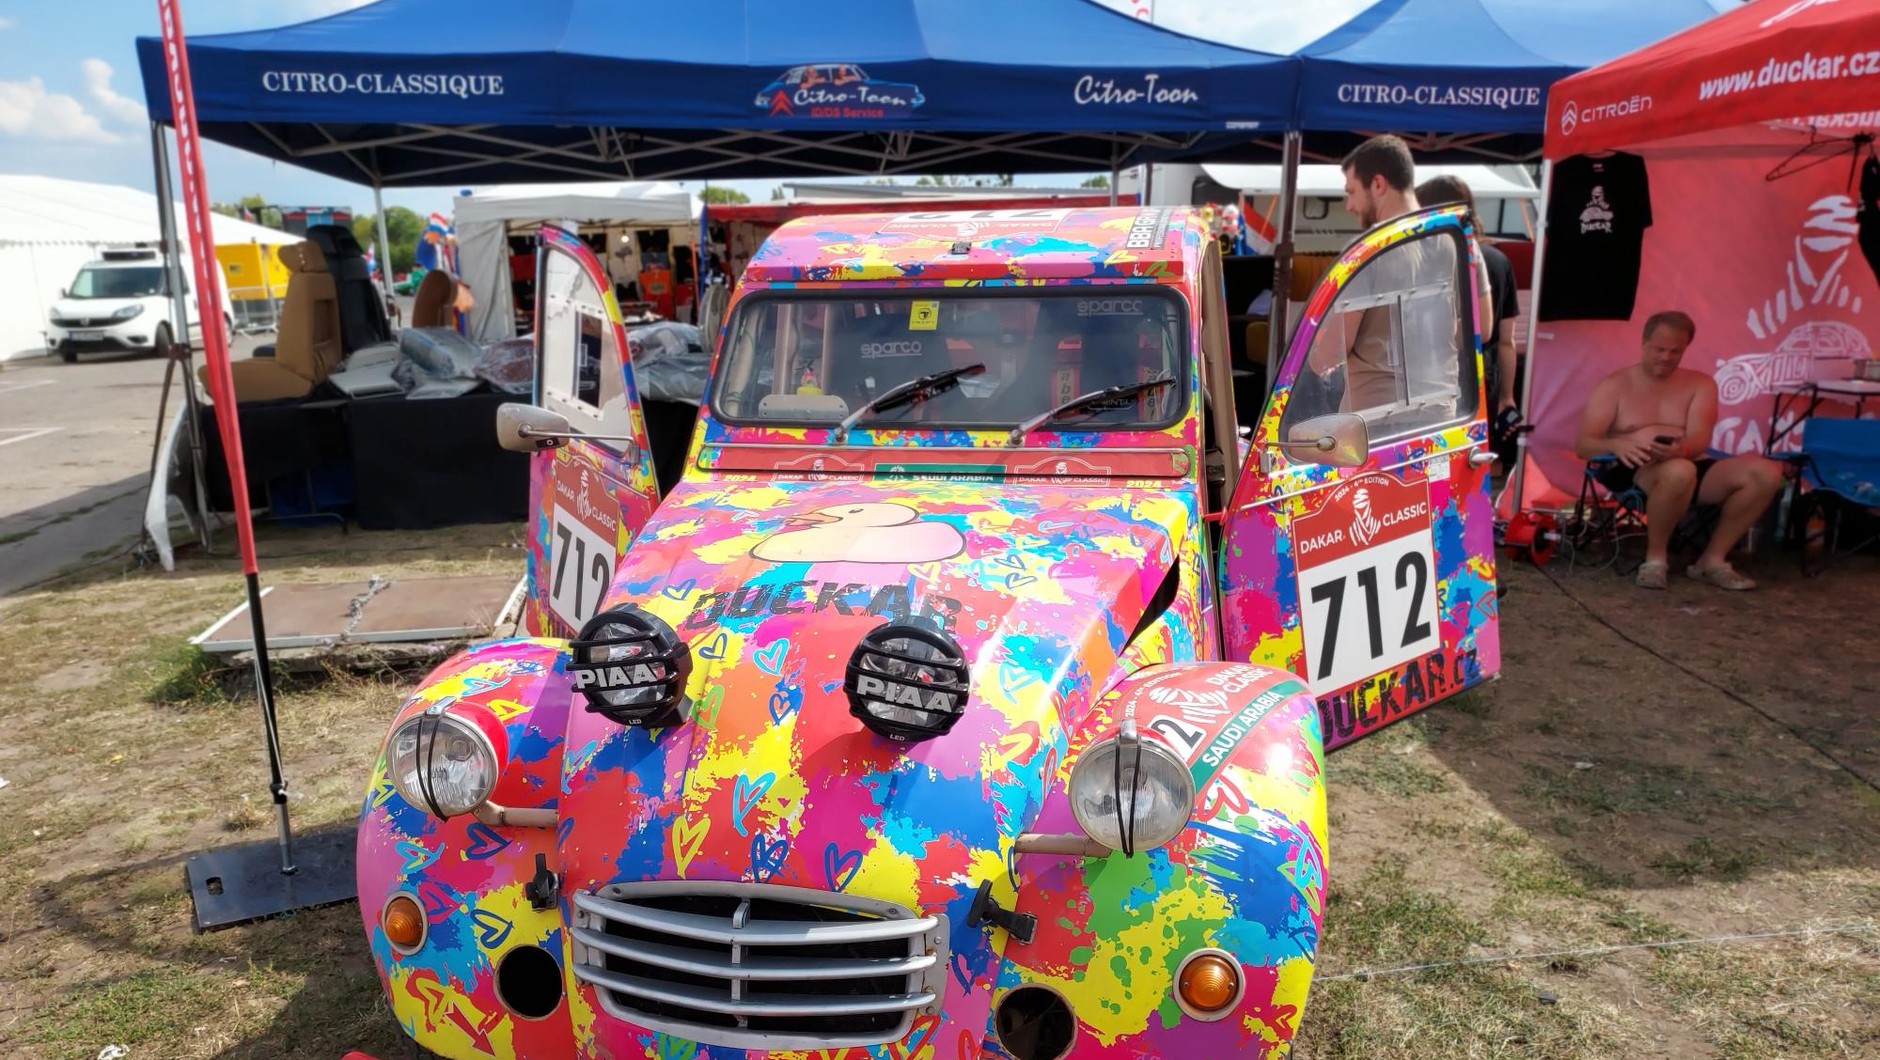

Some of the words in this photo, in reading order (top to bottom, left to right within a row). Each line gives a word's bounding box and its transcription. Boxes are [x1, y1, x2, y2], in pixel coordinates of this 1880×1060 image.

[262, 71, 504, 99] CITRO-CLASSIQUE
[1074, 74, 1199, 105] Citro-Toon
[1700, 51, 1880, 101] www.duckar.cz
[793, 86, 907, 106] Citro-Toon
[1337, 84, 1540, 109] CITRO-CLASSIQUE
[1581, 95, 1653, 124] CITROËN
[843, 108, 884, 118] Service
[860, 341, 922, 358] sparco
[1364, 477, 1389, 487] EDITION
[557, 480, 575, 502] DAKAR
[591, 508, 617, 532] CLASSIC
[1300, 529, 1344, 554] DAKAR
[1382, 502, 1427, 527] CLASSIC
[552, 521, 610, 621] 712
[1311, 551, 1431, 681] 712
[575, 663, 658, 689] PIAA
[1205, 664, 1252, 686] DAKAR
[1223, 668, 1274, 693] CLASSIC
[856, 674, 952, 713] PIAA
[1202, 723, 1247, 767] SAUDI
[1239, 690, 1285, 728] ARABIA
